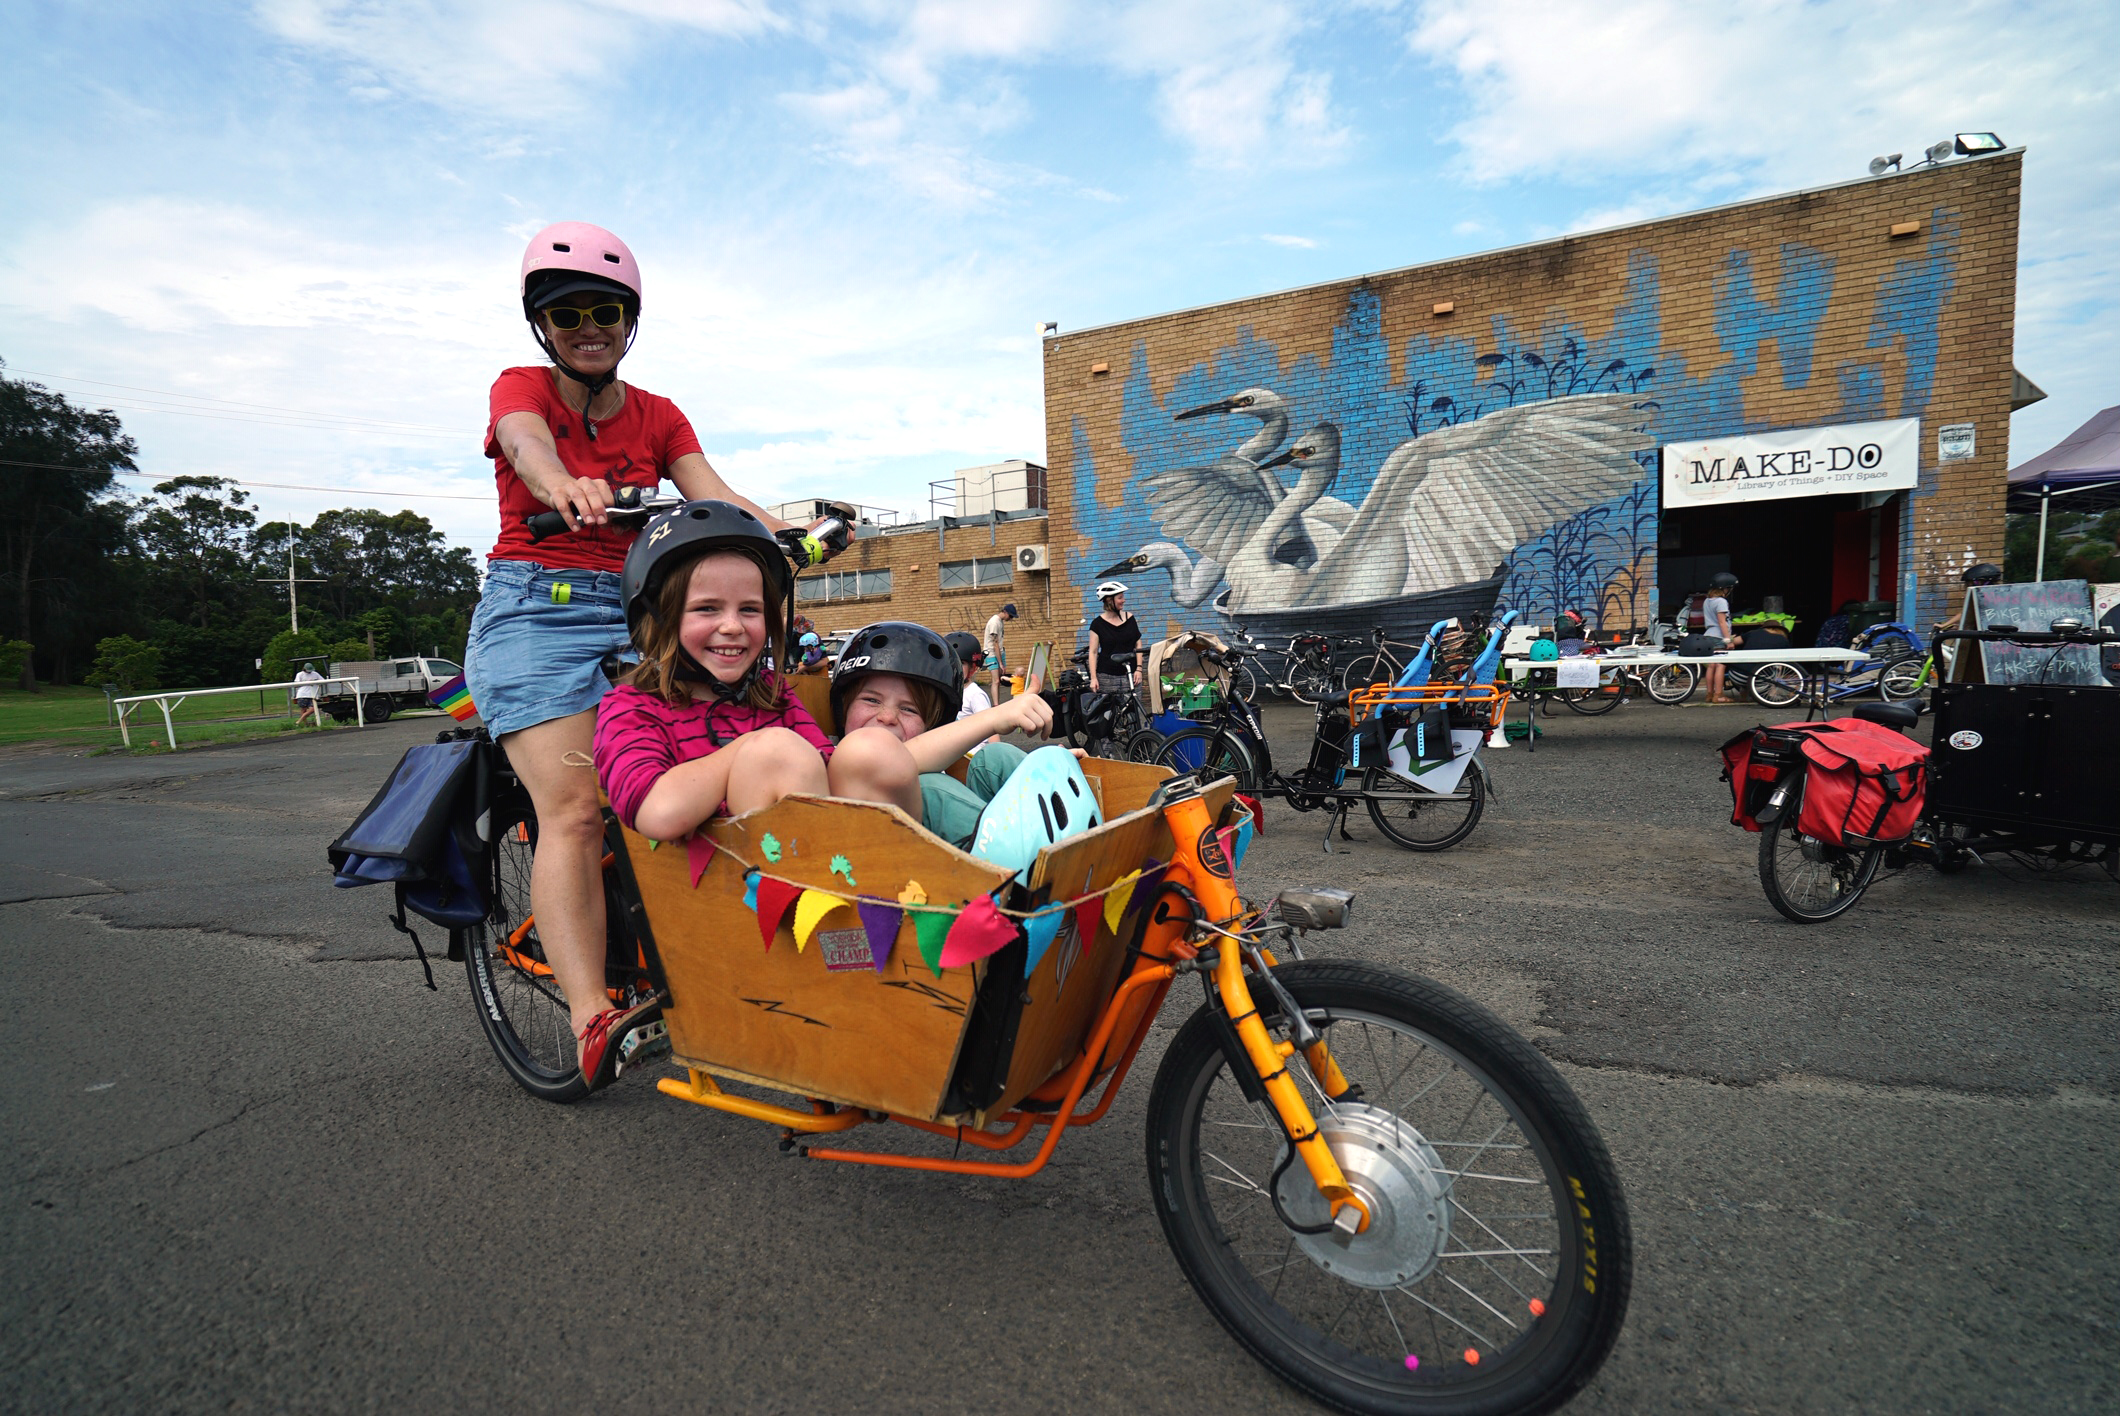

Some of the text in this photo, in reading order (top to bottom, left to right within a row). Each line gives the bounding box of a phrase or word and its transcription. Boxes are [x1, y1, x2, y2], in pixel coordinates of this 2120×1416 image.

[1690, 443, 1882, 484] MAKE-DO
[1737, 481, 1775, 491] Library
[1777, 479, 1788, 487] of
[1789, 475, 1824, 486] Things
[1835, 473, 1853, 482] DIY
[1856, 470, 1889, 482] Space
[1984, 607, 2021, 624] BIKE
[838, 655, 871, 673] REID
[2056, 660, 2101, 678] DRINKS
[830, 948, 870, 963] CHAMP
[1567, 1175, 1597, 1294] MAXXIS
